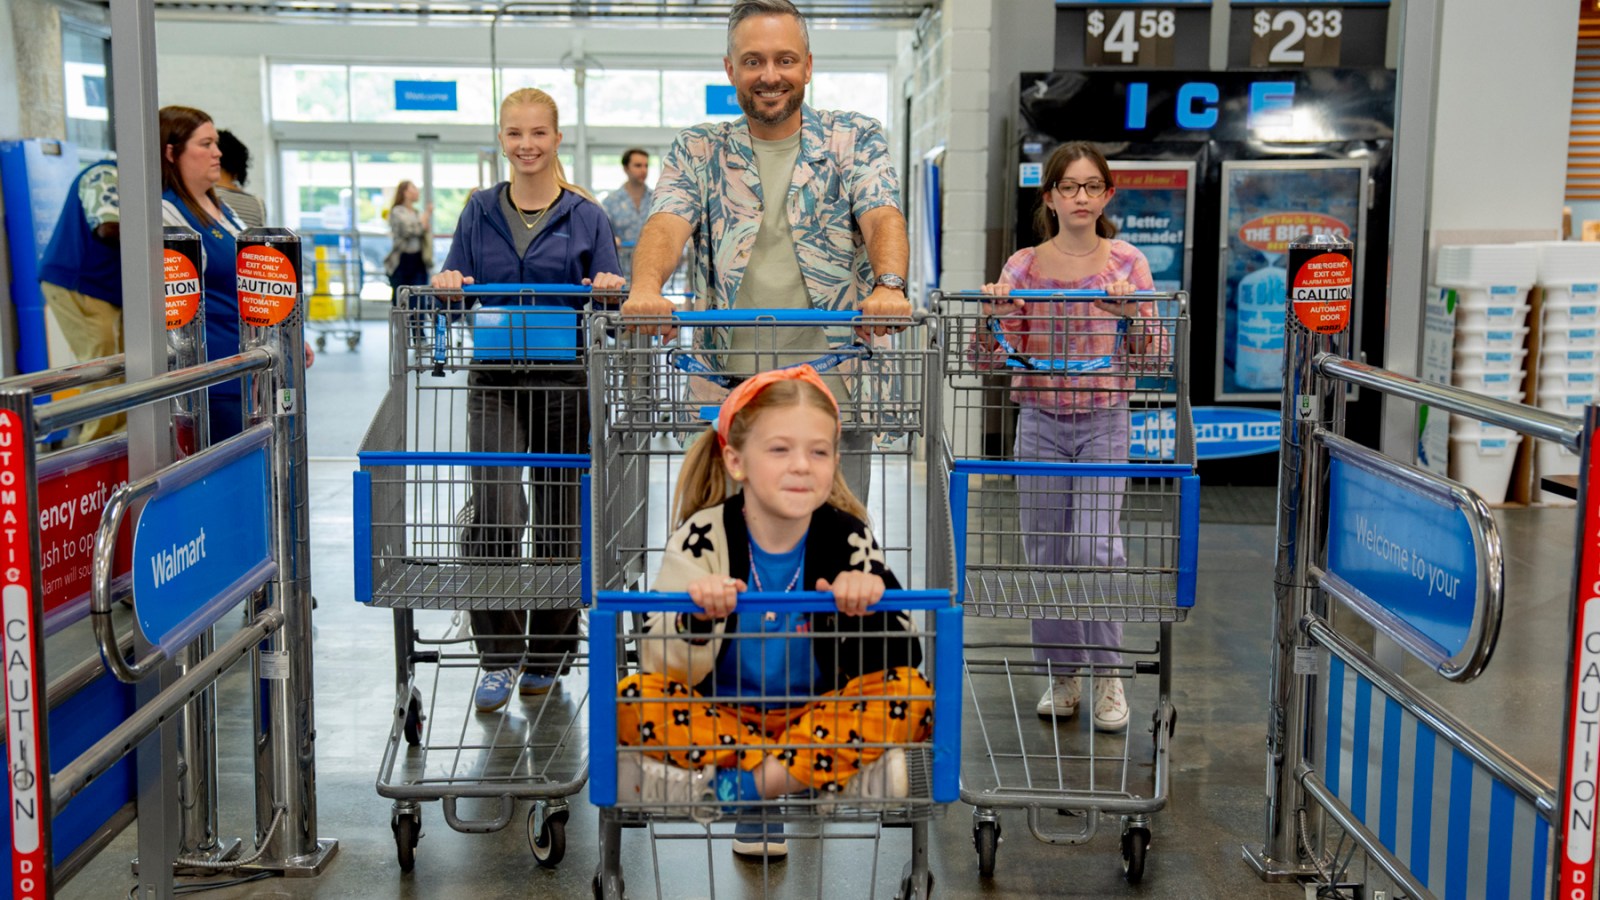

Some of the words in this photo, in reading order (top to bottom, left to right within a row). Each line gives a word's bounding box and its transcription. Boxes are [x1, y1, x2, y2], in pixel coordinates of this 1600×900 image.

[1125, 81, 1295, 129] ICE
[1127, 215, 1170, 229] Better
[1245, 227, 1271, 241] THE
[1276, 224, 1309, 242] BIG
[242, 252, 285, 264] EMERGENCY
[246, 261, 261, 269] EXIT
[1307, 261, 1349, 270] EMERGENCY
[253, 270, 266, 278] WILL
[267, 272, 289, 280] SOUND
[242, 296, 280, 307] AUTOMATIC
[1310, 305, 1347, 313] AUTOMATIC
[249, 306, 270, 315] DOOR
[246, 316, 270, 325] wanzi
[1243, 424, 1281, 437] Ice
[0, 413, 20, 582] AUTOMATIC
[80, 481, 107, 515] exit
[41, 541, 60, 570] ush
[63, 539, 76, 560] to
[151, 527, 206, 589] Walmart
[1356, 514, 1409, 571] Welcome
[1411, 548, 1426, 580] to
[1428, 563, 1460, 600] your
[64, 566, 77, 585] will
[78, 563, 93, 579] sou
[6, 620, 35, 820] CAUTION
[1572, 631, 1600, 831] CAUTION
